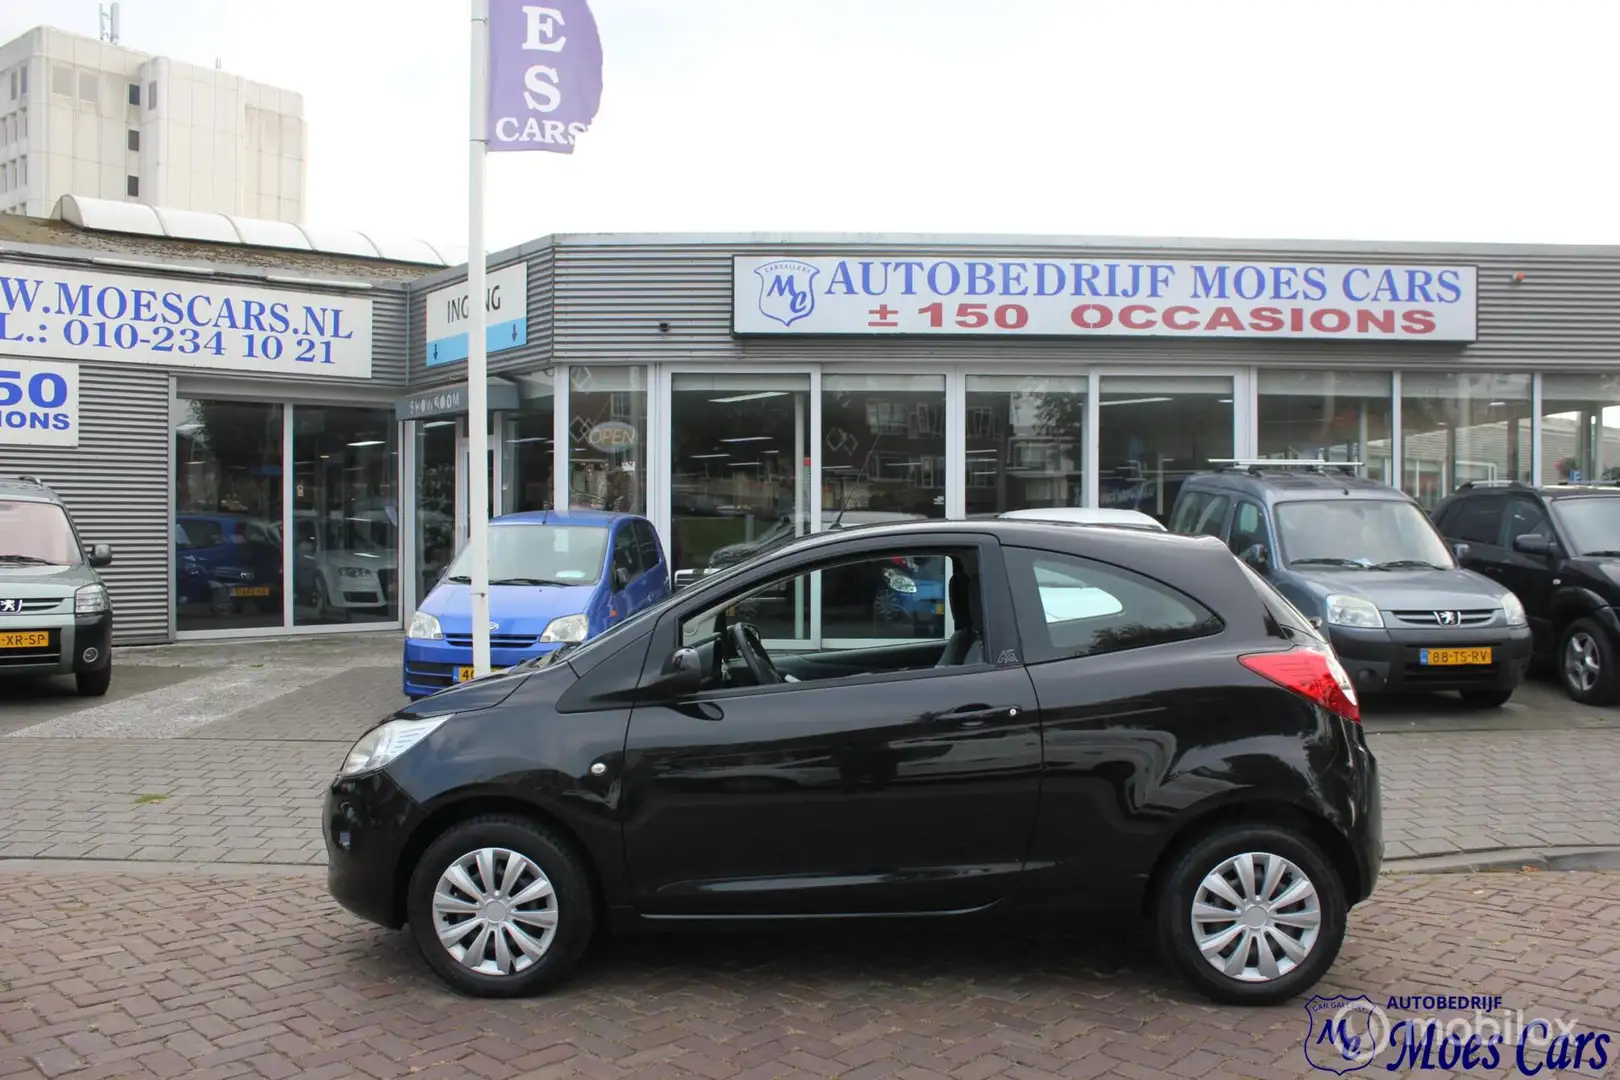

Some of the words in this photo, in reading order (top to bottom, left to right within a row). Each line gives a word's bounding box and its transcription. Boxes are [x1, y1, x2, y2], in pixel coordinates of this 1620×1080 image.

[495, 117, 588, 145] CARS
[824, 260, 1176, 298] AUTOBEDRIJF
[1190, 264, 1328, 301] MOES
[1342, 268, 1462, 304] CARS
[0, 276, 354, 340] W.MOESCARS.NL
[918, 303, 1029, 329] 150
[1070, 303, 1436, 334] OCCASIONS
[63, 319, 227, 356] 010-234
[242, 333, 283, 360] 10
[295, 339, 336, 365] 21
[0, 410, 70, 430] ONS
[588, 428, 633, 445] OPEN
[1432, 650, 1488, 663] 88-TS-RV
